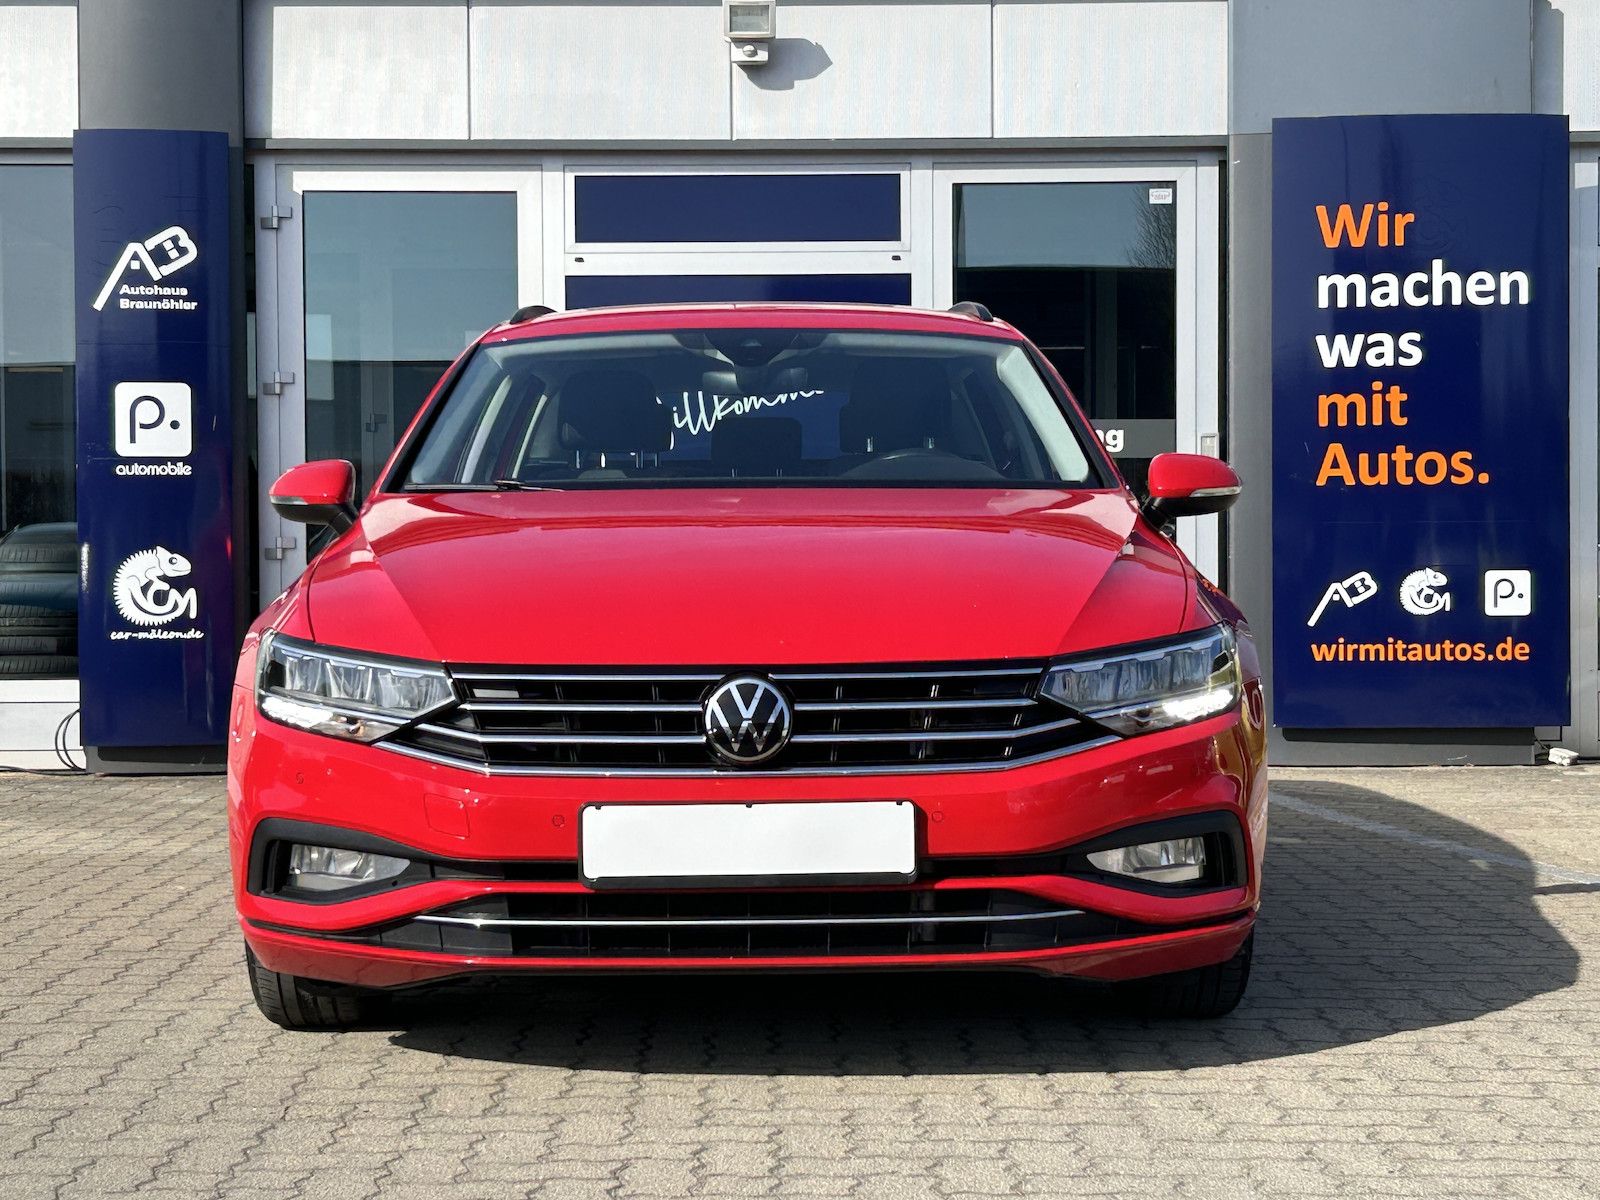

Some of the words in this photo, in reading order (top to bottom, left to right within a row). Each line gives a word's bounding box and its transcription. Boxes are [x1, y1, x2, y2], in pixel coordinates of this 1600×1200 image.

[1315, 202, 1415, 248] Wir
[119, 284, 189, 296] Autohaus
[1317, 259, 1530, 309] machen
[119, 298, 198, 311] Braunöhler
[1315, 331, 1423, 368] was
[1317, 381, 1409, 427] mit
[115, 461, 192, 476] automobile
[1315, 442, 1490, 486] Autos.
[1310, 636, 1531, 661] wirmitautos.de
